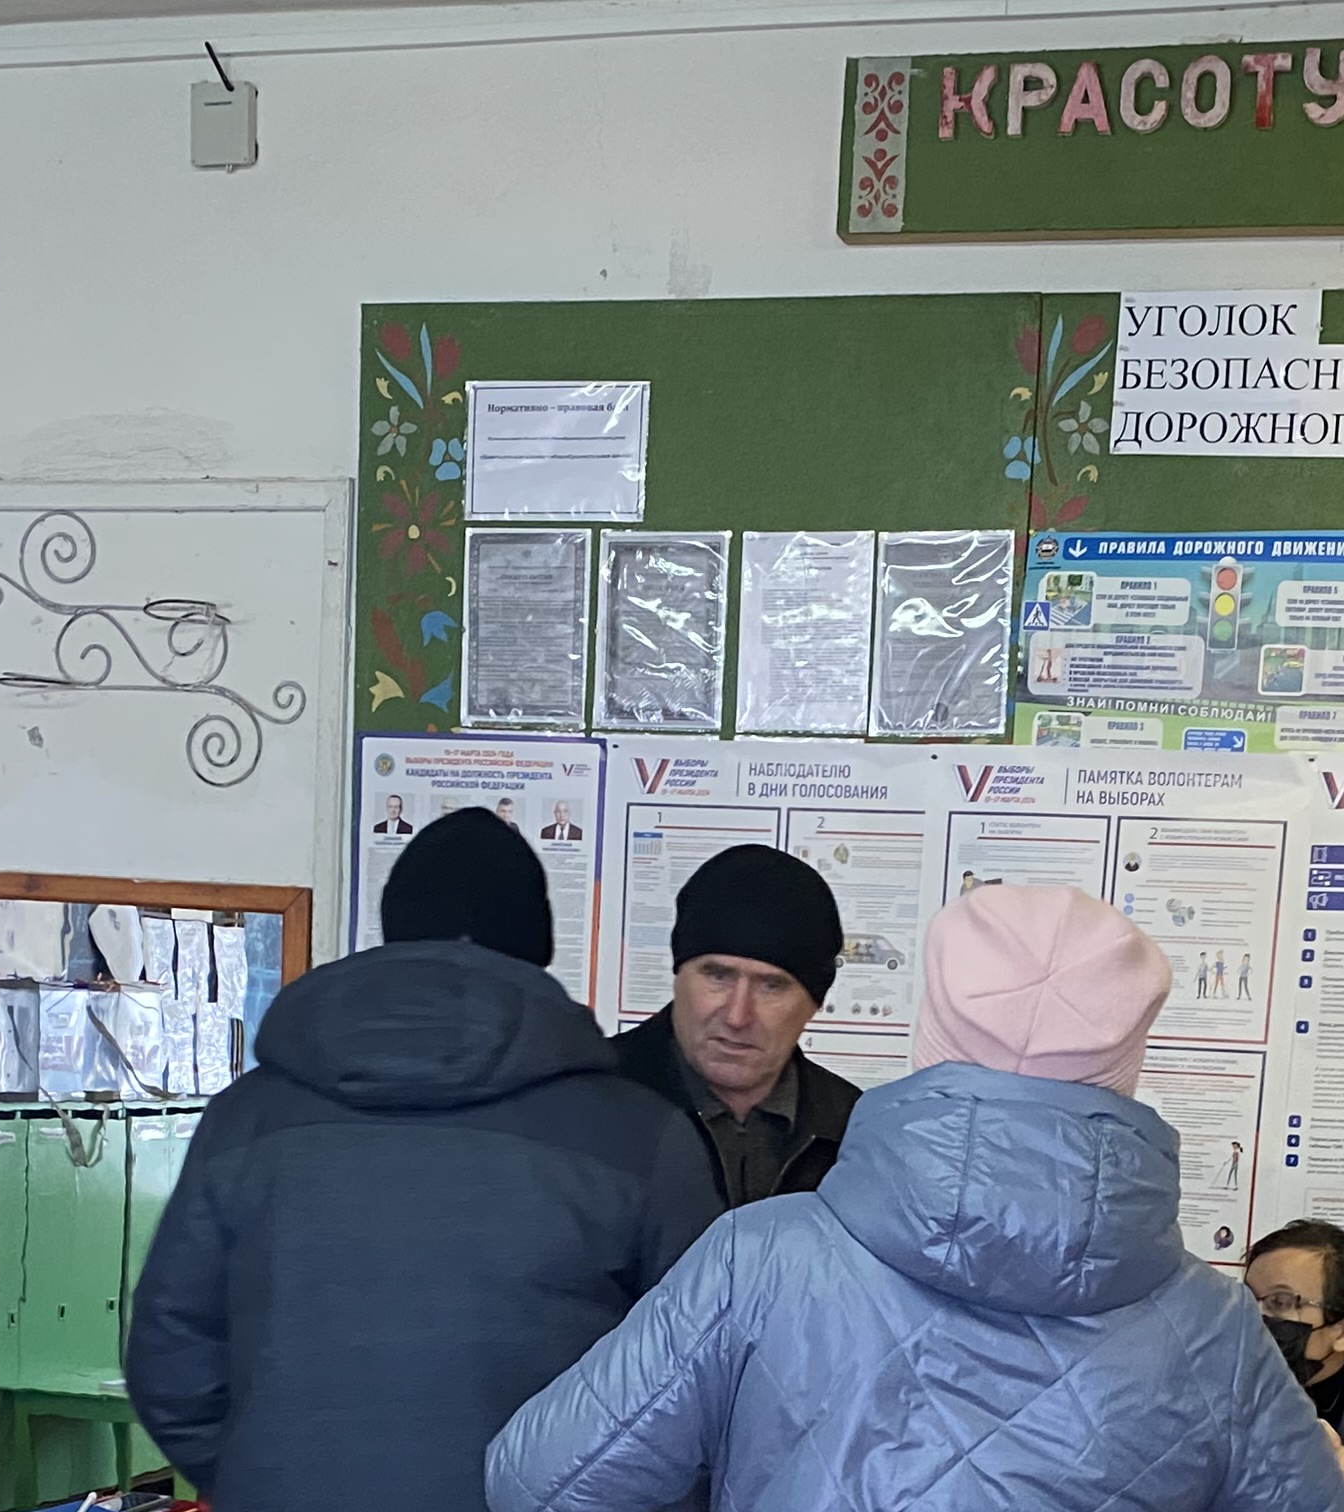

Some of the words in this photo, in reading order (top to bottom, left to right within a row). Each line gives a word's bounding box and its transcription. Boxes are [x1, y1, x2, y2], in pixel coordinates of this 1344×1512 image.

[1125, 303, 1297, 337] УГОЛОК
[487, 402, 549, 415] Нормативно
[1098, 540, 1166, 556] ПРАВИЛА
[1172, 540, 1265, 557] ДОРОЖНОГО
[1115, 699, 1175, 714] ПОМНИ!
[748, 761, 851, 779] НАБЛЮДАТЕЛЮ
[1077, 769, 1144, 786] ПАМЯТКА
[1148, 772, 1243, 789] ВОЛОНТЕРАМ
[747, 782, 756, 797] В
[759, 783, 788, 799] ДНИ
[791, 783, 888, 800] ГОЛОСОВАНИЯ
[1076, 789, 1095, 806] НА
[1098, 790, 1166, 808] ВЫБОРАХ
[656, 811, 662, 823] 1
[817, 816, 825, 829] 2
[979, 821, 986, 835] 1
[1149, 826, 1158, 840] 2
